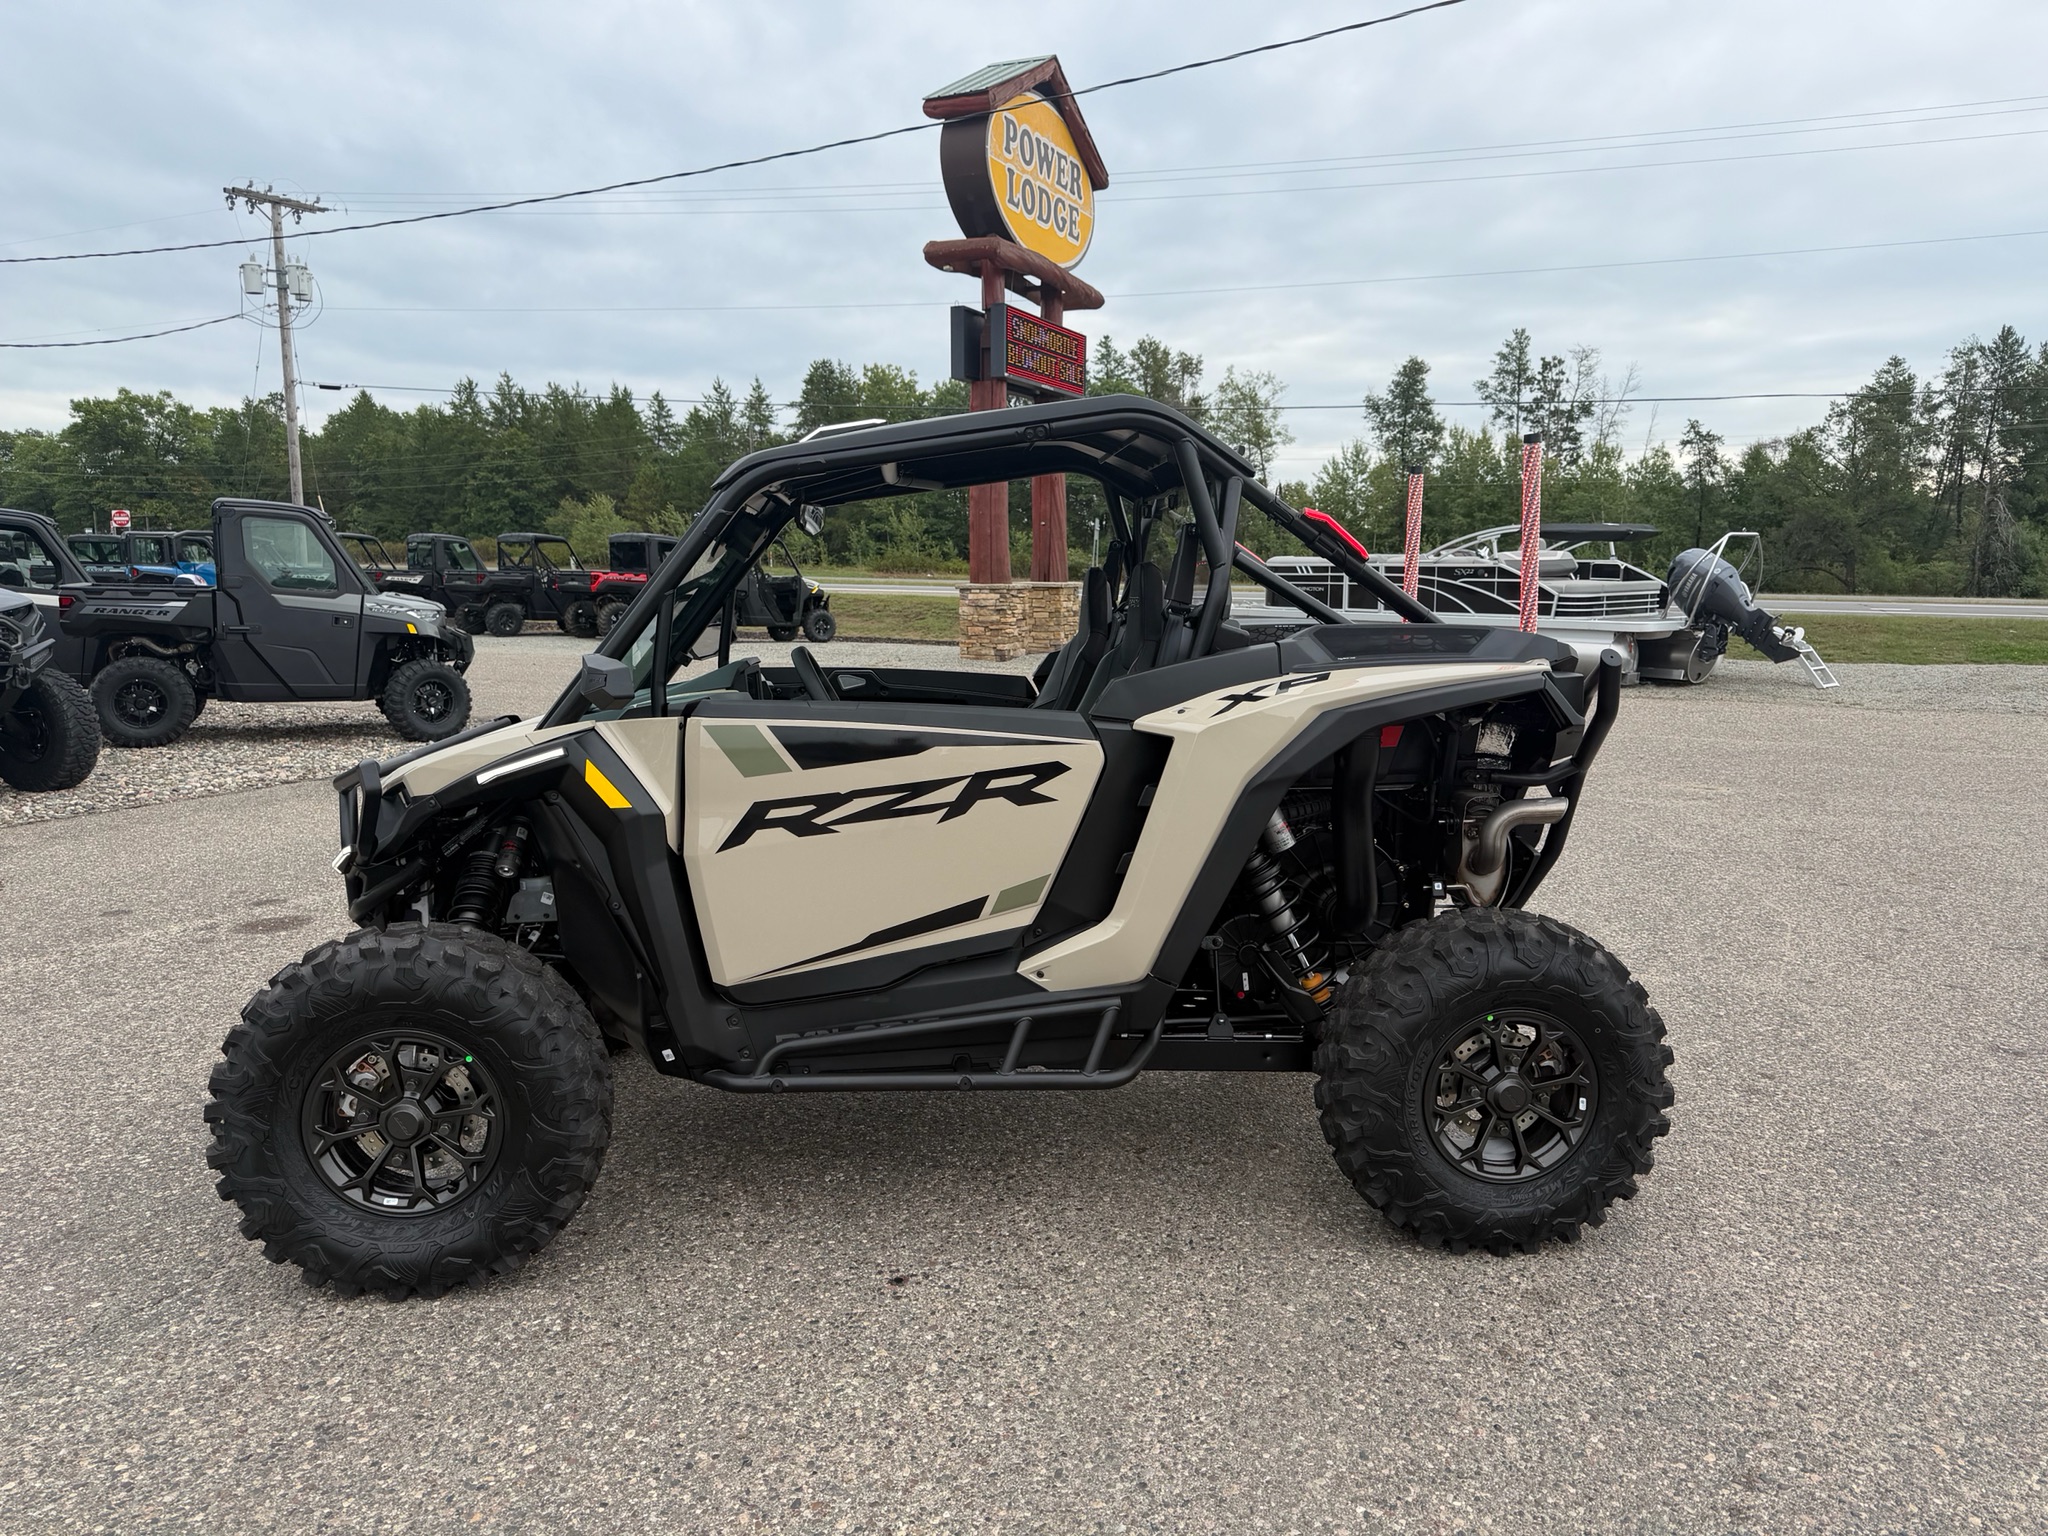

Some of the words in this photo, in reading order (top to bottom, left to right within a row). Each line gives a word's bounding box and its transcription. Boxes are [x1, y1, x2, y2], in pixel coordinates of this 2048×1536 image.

[1003, 115, 1083, 200] POWER
[1006, 167, 1080, 242] LODGE
[1012, 317, 1078, 359] SNOWMOBILE
[1007, 343, 1055, 377] BLOWOUT
[1059, 360, 1083, 385] SALE
[1453, 568, 1475, 576] SX22
[1683, 572, 1699, 593] YAMAHA
[93, 607, 171, 617] RANGER
[1209, 672, 1331, 719] XP
[715, 760, 1072, 854] RZR
